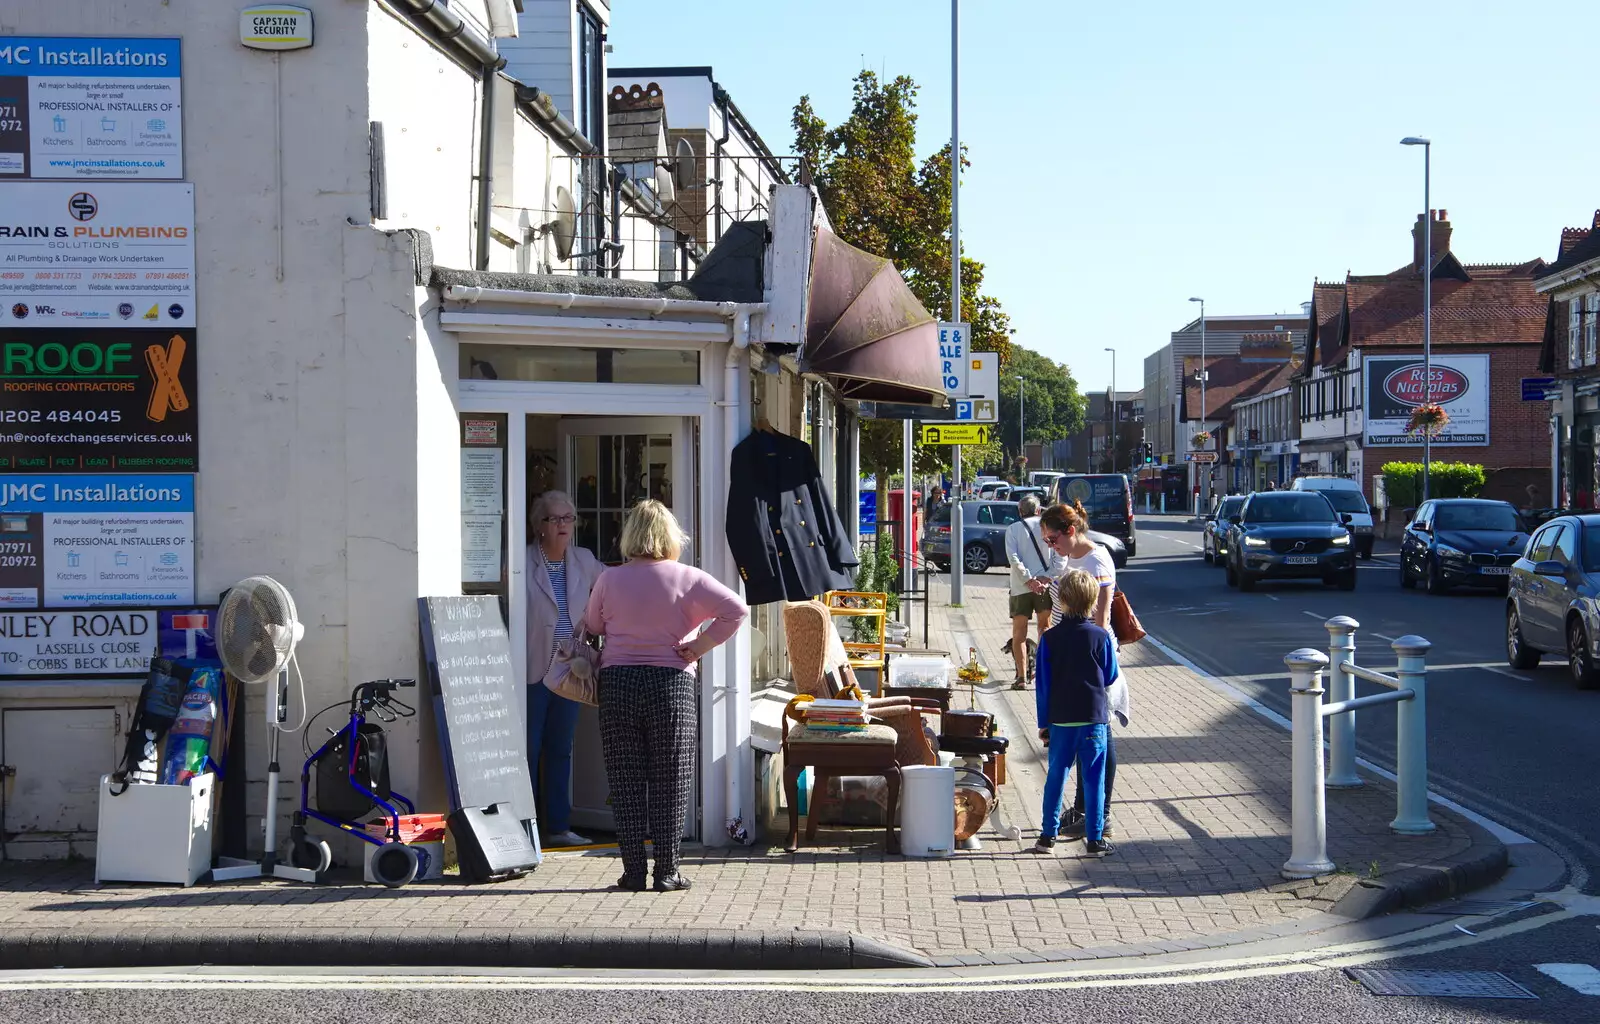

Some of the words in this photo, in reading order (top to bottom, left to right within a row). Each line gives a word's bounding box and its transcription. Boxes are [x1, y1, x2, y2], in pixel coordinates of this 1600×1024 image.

[253, 17, 297, 26] CAPSTAN
[253, 26, 296, 35] SECURITY
[38, 46, 168, 66] Installations
[48, 83, 65, 91] major
[66, 82, 90, 92] building
[91, 82, 135, 90] refurbishments
[87, 92, 100, 100] large
[39, 102, 105, 111] PROFESSIONAL
[107, 102, 157, 111] INSTALLERS
[160, 103, 173, 112] OF
[1, 120, 22, 131] 972
[43, 137, 74, 146] Kitchens
[86, 137, 127, 147] Bathrooms
[49, 158, 165, 169] www.jmcinstallations.co.uk
[54, 226, 69, 237] &
[74, 227, 188, 238] PLUMBING
[48, 241, 120, 249] SOLUTIONS
[17, 255, 53, 264] Plumbing
[63, 255, 97, 264] Drainage
[120, 255, 164, 263] Undertaken
[952, 330, 961, 342] &
[4, 343, 133, 374] ROOF
[4, 382, 53, 391] ROOFING
[56, 382, 135, 391] CONTRACTORS
[46, 410, 122, 422] 484045
[1372, 435, 1392, 443] Your
[1451, 434, 1484, 442] business
[18, 458, 46, 466] SLATE
[56, 458, 76, 466] FELT
[86, 458, 108, 466] LEAD
[119, 458, 154, 466] RUBBER
[156, 458, 194, 466] ROOFING
[1, 483, 46, 505] JMC
[54, 483, 181, 502] Installations
[81, 518, 104, 526] building
[53, 537, 118, 546] PROFESSIONAL
[121, 537, 170, 546] INSTALLERS
[173, 537, 186, 546] OF
[56, 572, 87, 580] Kitchens
[100, 572, 139, 580] Bathrooms
[63, 593, 177, 602] www.jmcinstallations.co.uk
[445, 603, 482, 620] WANTED
[73, 614, 149, 637] ROAD
[37, 643, 95, 655] LASSELLS
[101, 642, 140, 653] CLOSE
[3, 652, 23, 663] TO:
[28, 659, 68, 670] COBBS
[75, 658, 109, 669] BECK
[115, 657, 149, 668] LANE
